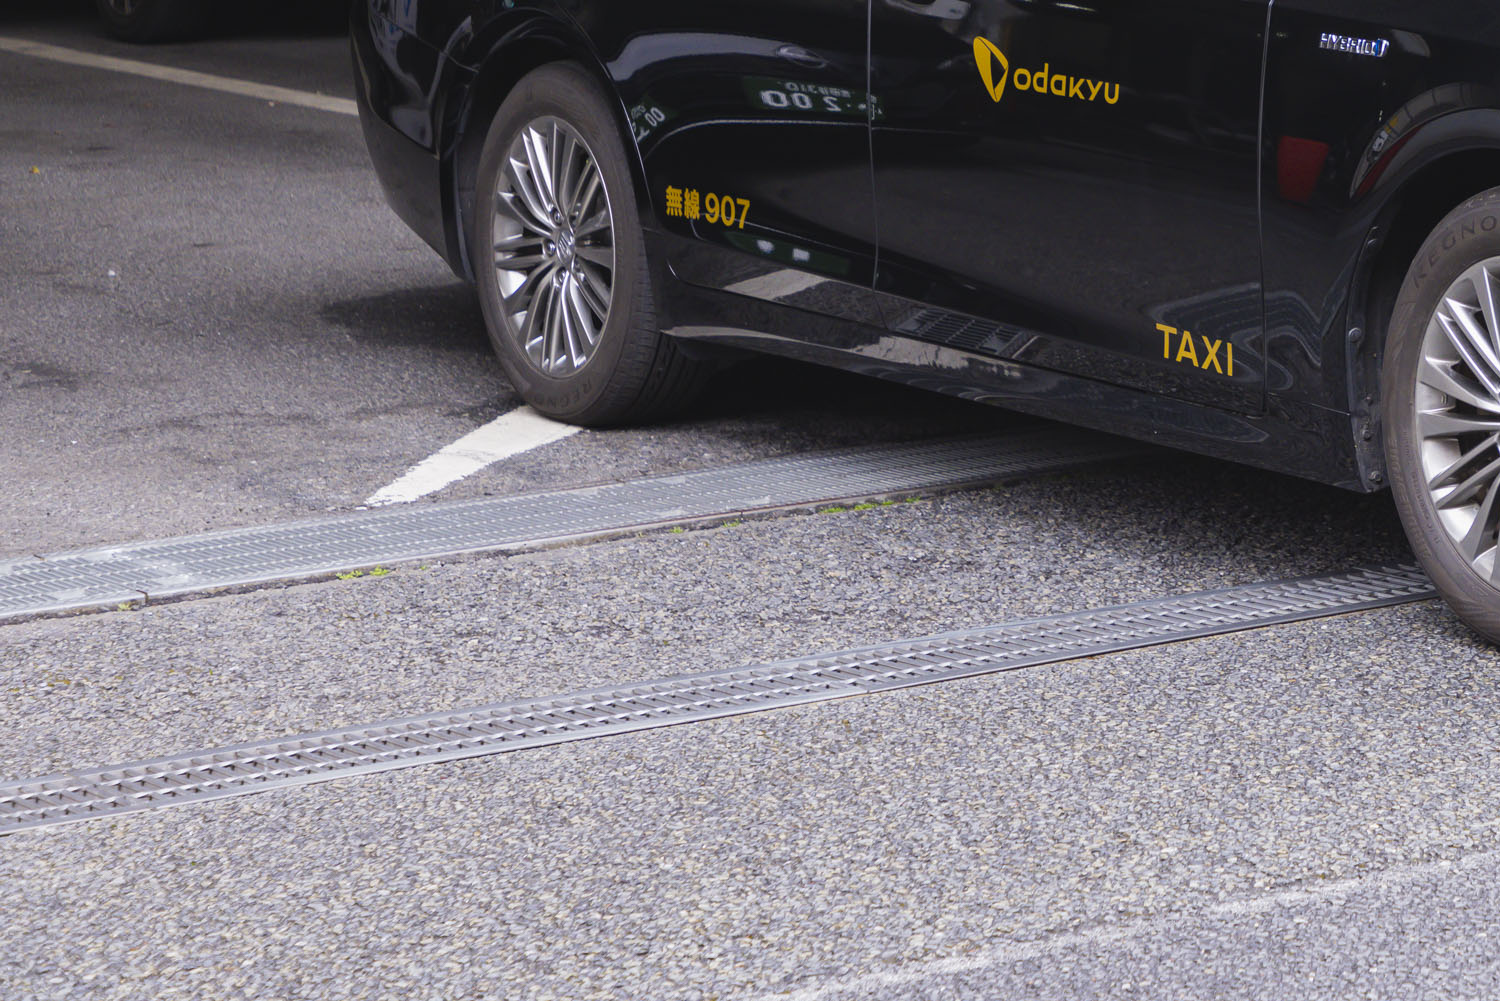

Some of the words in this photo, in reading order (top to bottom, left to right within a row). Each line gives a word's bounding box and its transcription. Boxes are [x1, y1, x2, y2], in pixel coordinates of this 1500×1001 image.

[1013, 63, 1120, 105] odakyu
[666, 185, 700, 220] 無線
[705, 192, 750, 229] 907
[1155, 323, 1233, 377] TAXI
